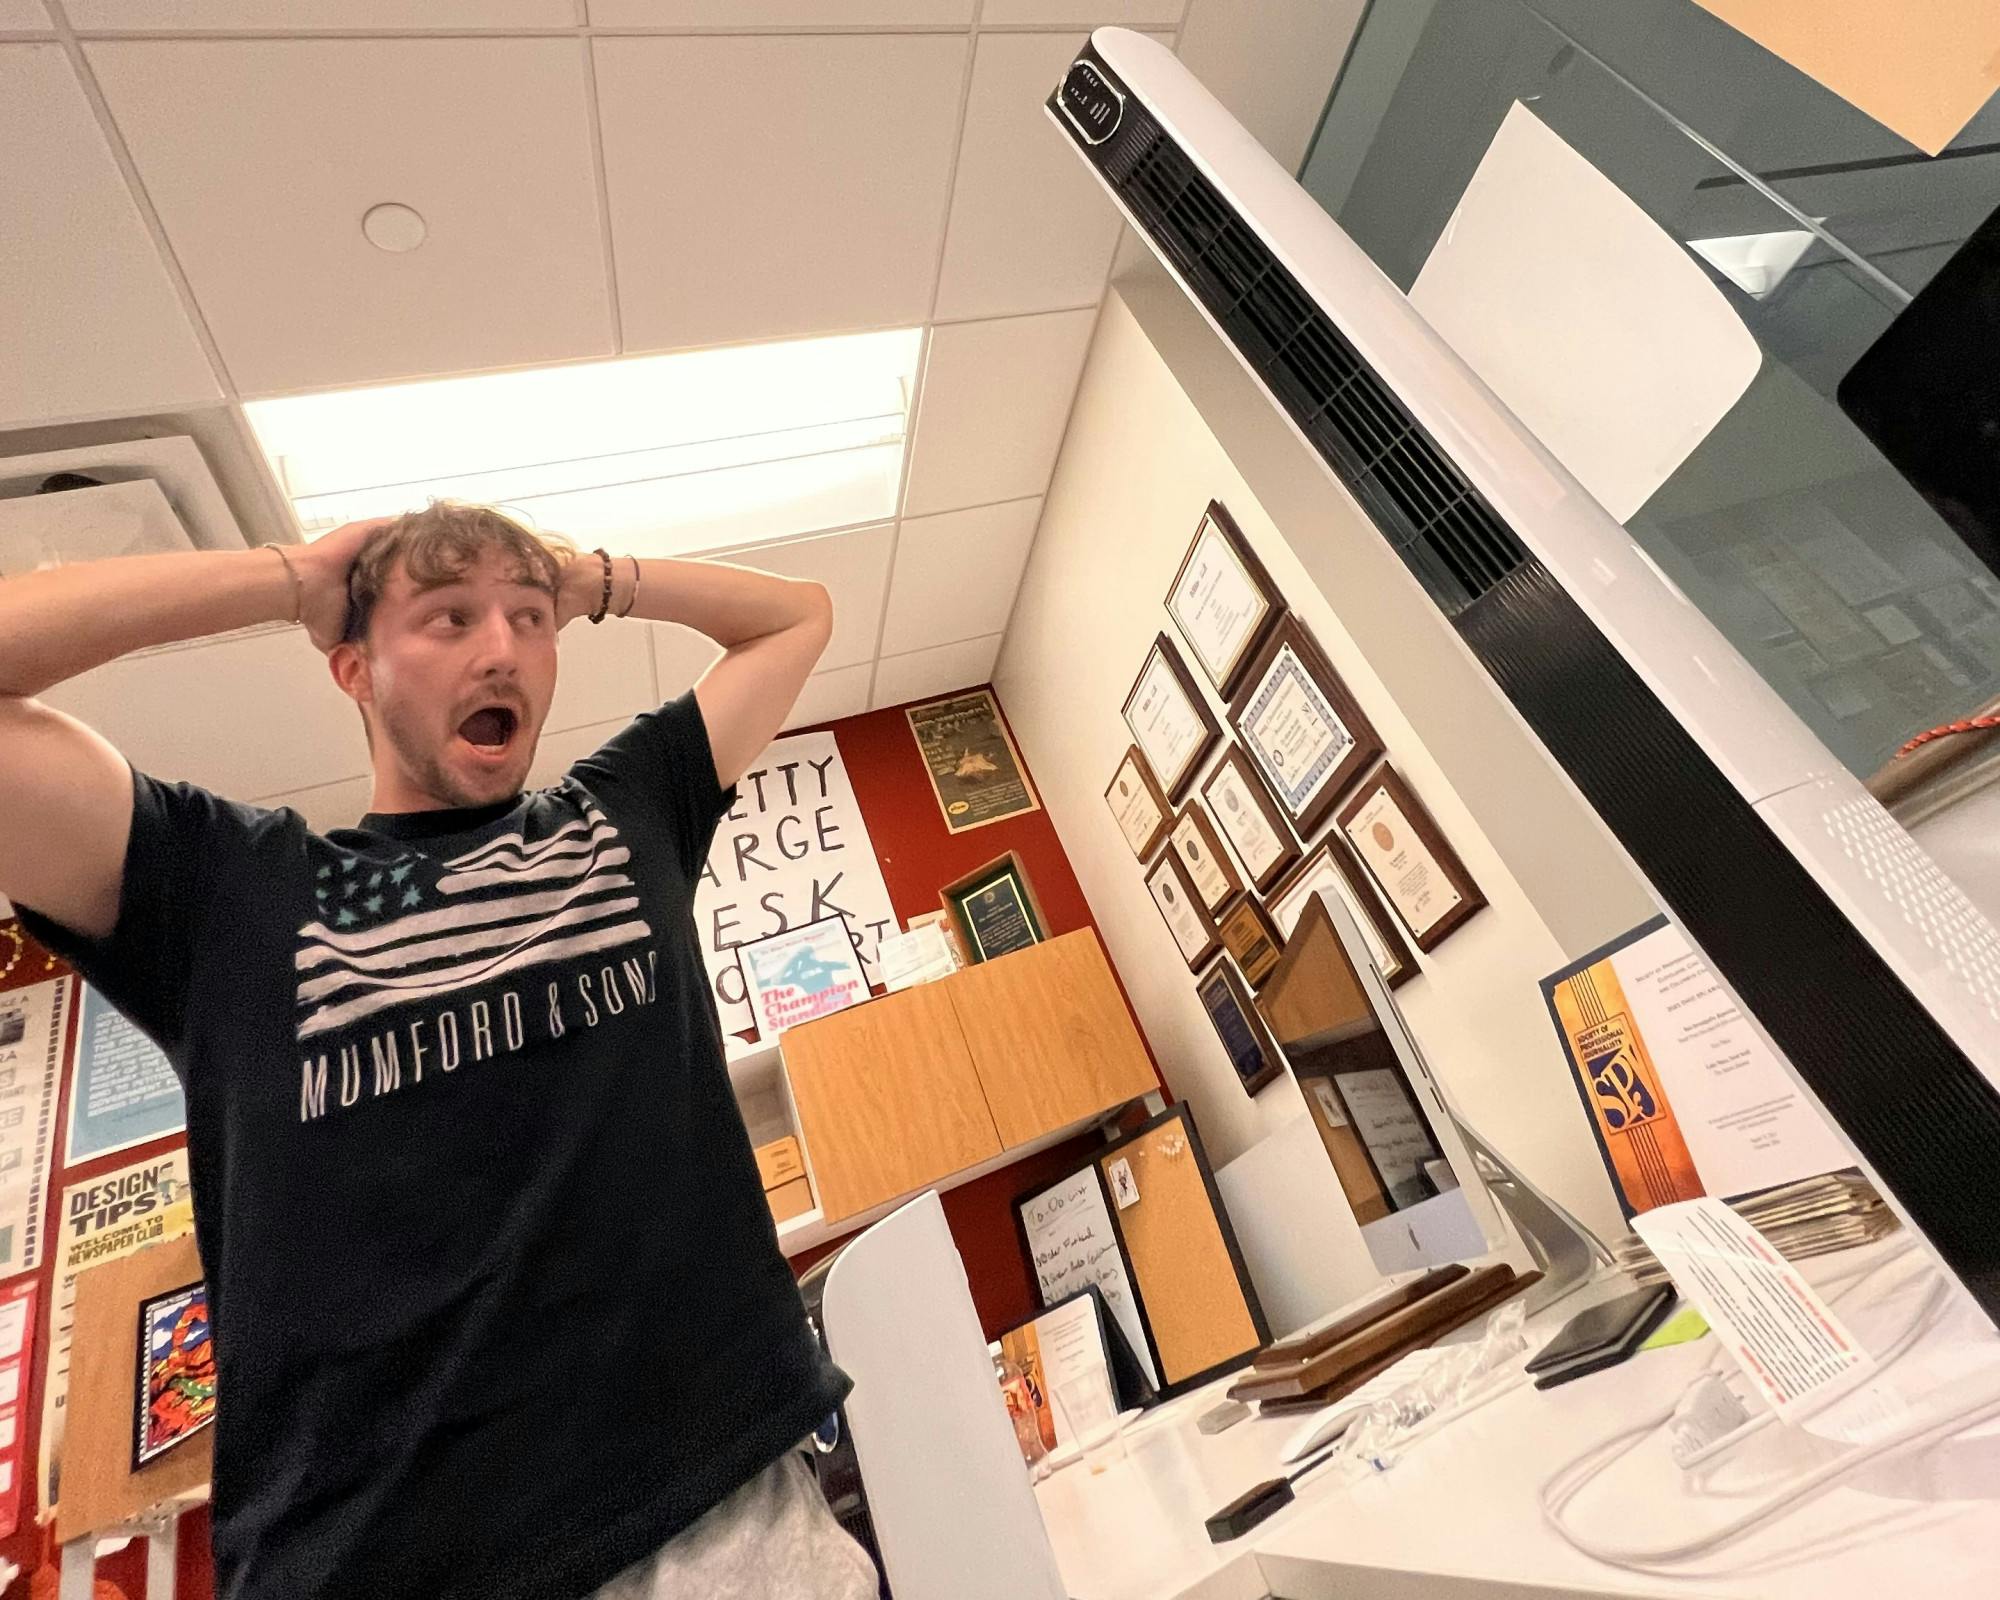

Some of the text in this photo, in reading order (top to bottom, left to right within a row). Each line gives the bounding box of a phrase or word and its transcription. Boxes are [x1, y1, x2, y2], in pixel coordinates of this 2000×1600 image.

[718, 755, 834, 823] ETTY
[761, 986, 795, 1005] The
[764, 979, 859, 1018] Champion
[301, 991, 525, 1122] MUMFORD
[548, 982, 566, 1038] &
[1577, 1024, 1609, 1044] SOCIETY OF
[1580, 1028, 1625, 1052] PROFESSIONAL
[70, 1166, 159, 1217] DESIGN
[67, 1223, 164, 1267] NEWSPAPER CLUB
[70, 1215, 164, 1252] WELCOME TO
